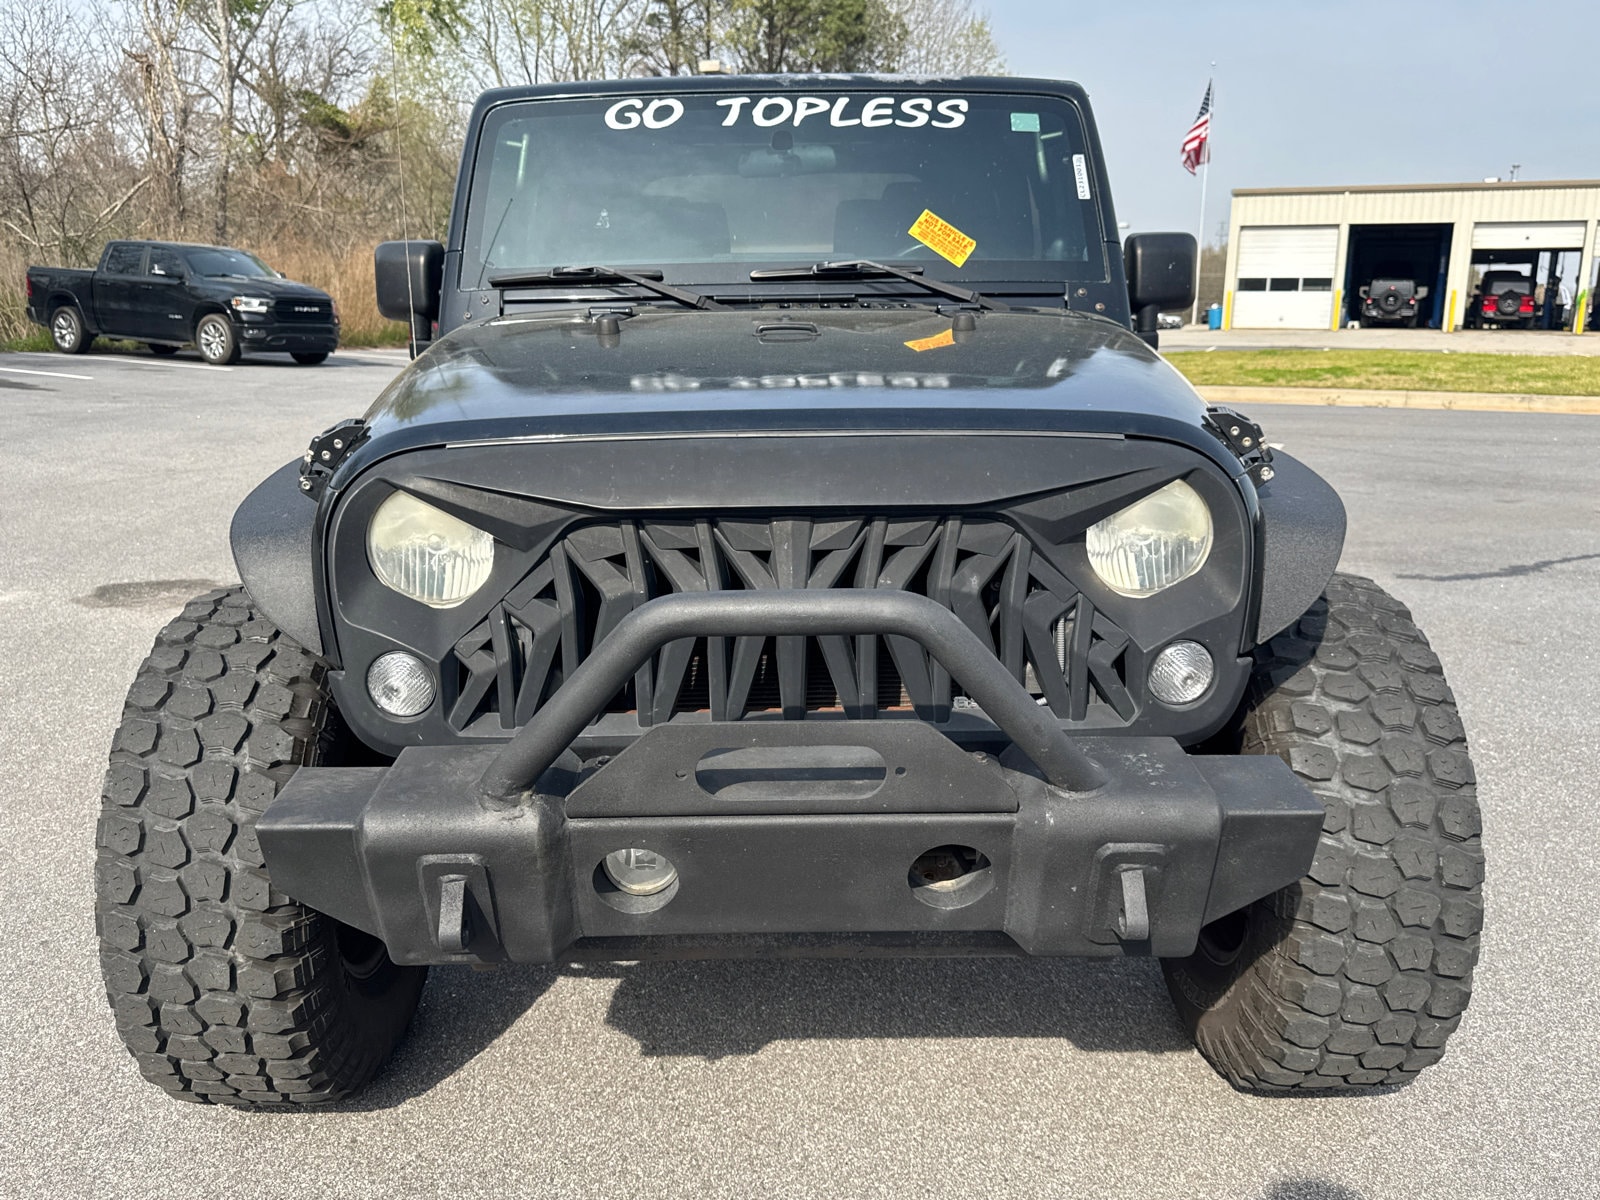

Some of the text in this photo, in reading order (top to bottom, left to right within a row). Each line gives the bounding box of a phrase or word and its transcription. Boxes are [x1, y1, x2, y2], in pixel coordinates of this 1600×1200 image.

[604, 97, 969, 130] GO TOPLESS
[924, 218, 969, 249] NOT FOR SALE
[925, 212, 939, 225] THIS
[940, 222, 966, 242] VEHICLE
